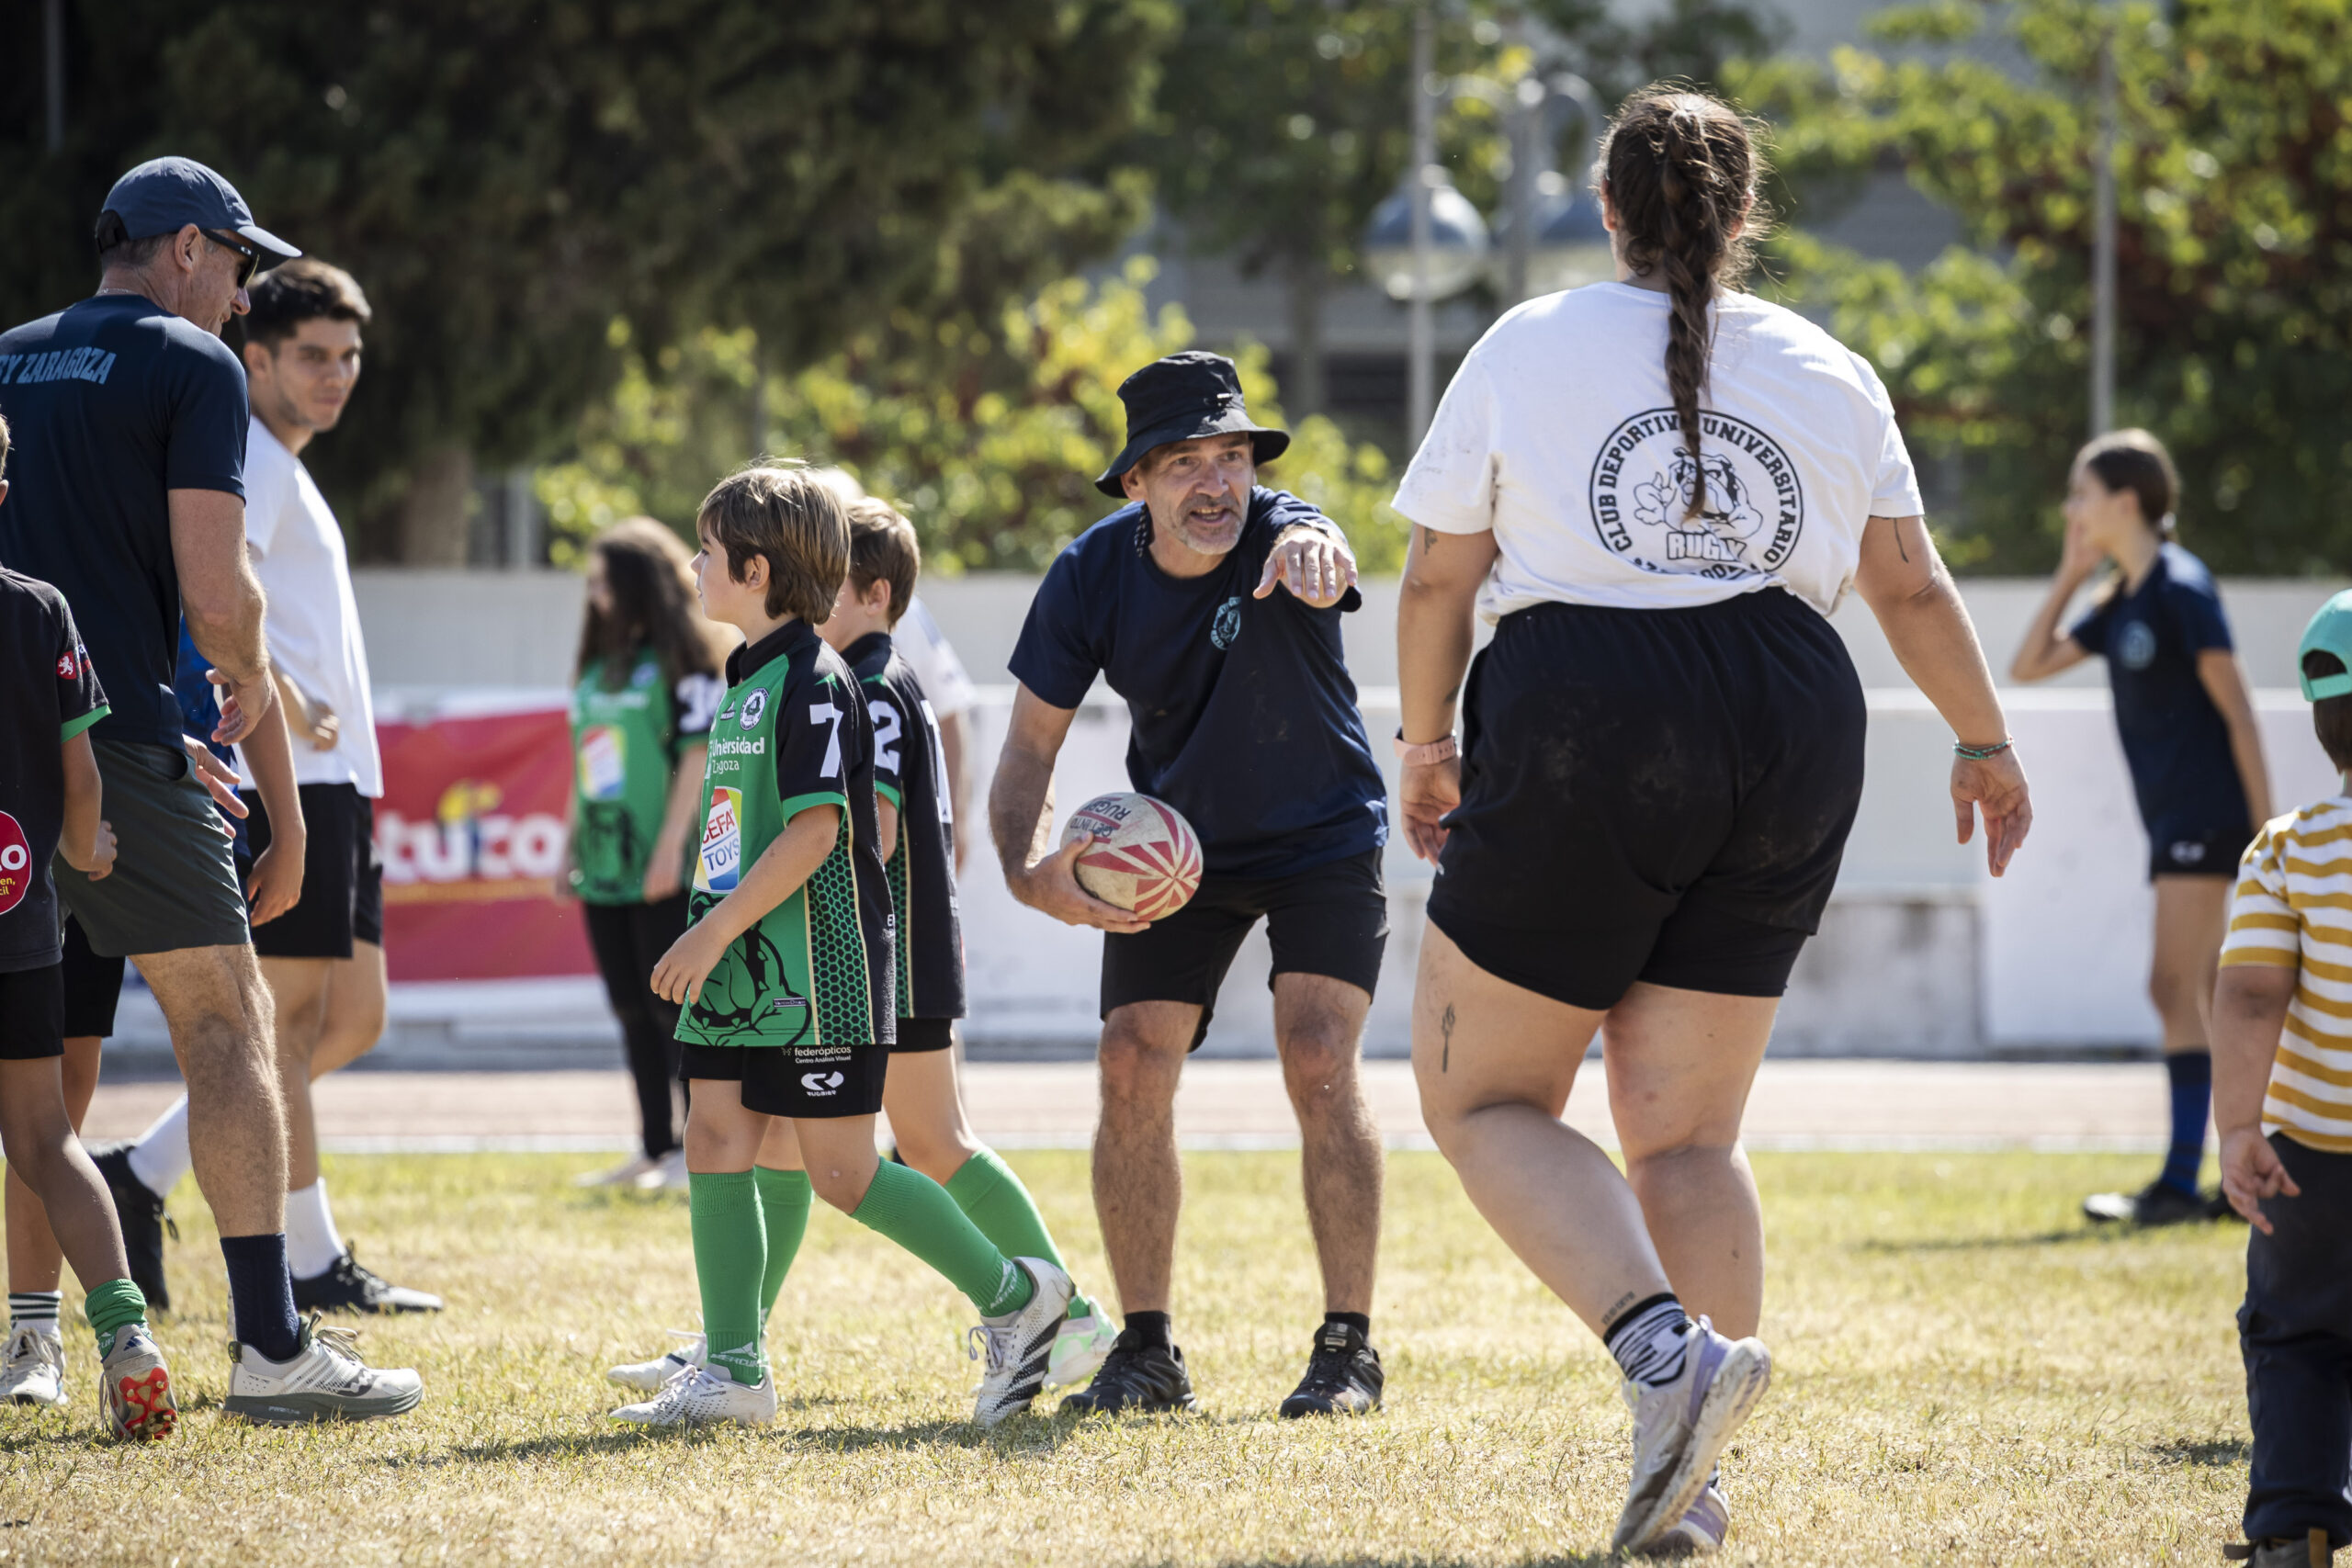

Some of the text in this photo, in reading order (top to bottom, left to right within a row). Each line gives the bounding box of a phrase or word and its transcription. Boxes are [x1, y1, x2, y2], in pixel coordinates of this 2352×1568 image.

[16, 346, 117, 385] ZARAGOZA
[1599, 414, 1797, 564] CLUB DEPORTIV UNIVERSITARIO
[712, 736, 764, 757] Uniersidad
[808, 702, 844, 778] 7
[867, 700, 902, 776] 2
[0, 844, 27, 872] o
[704, 838, 740, 871] TOYS
[794, 1045, 852, 1057] federópticos
